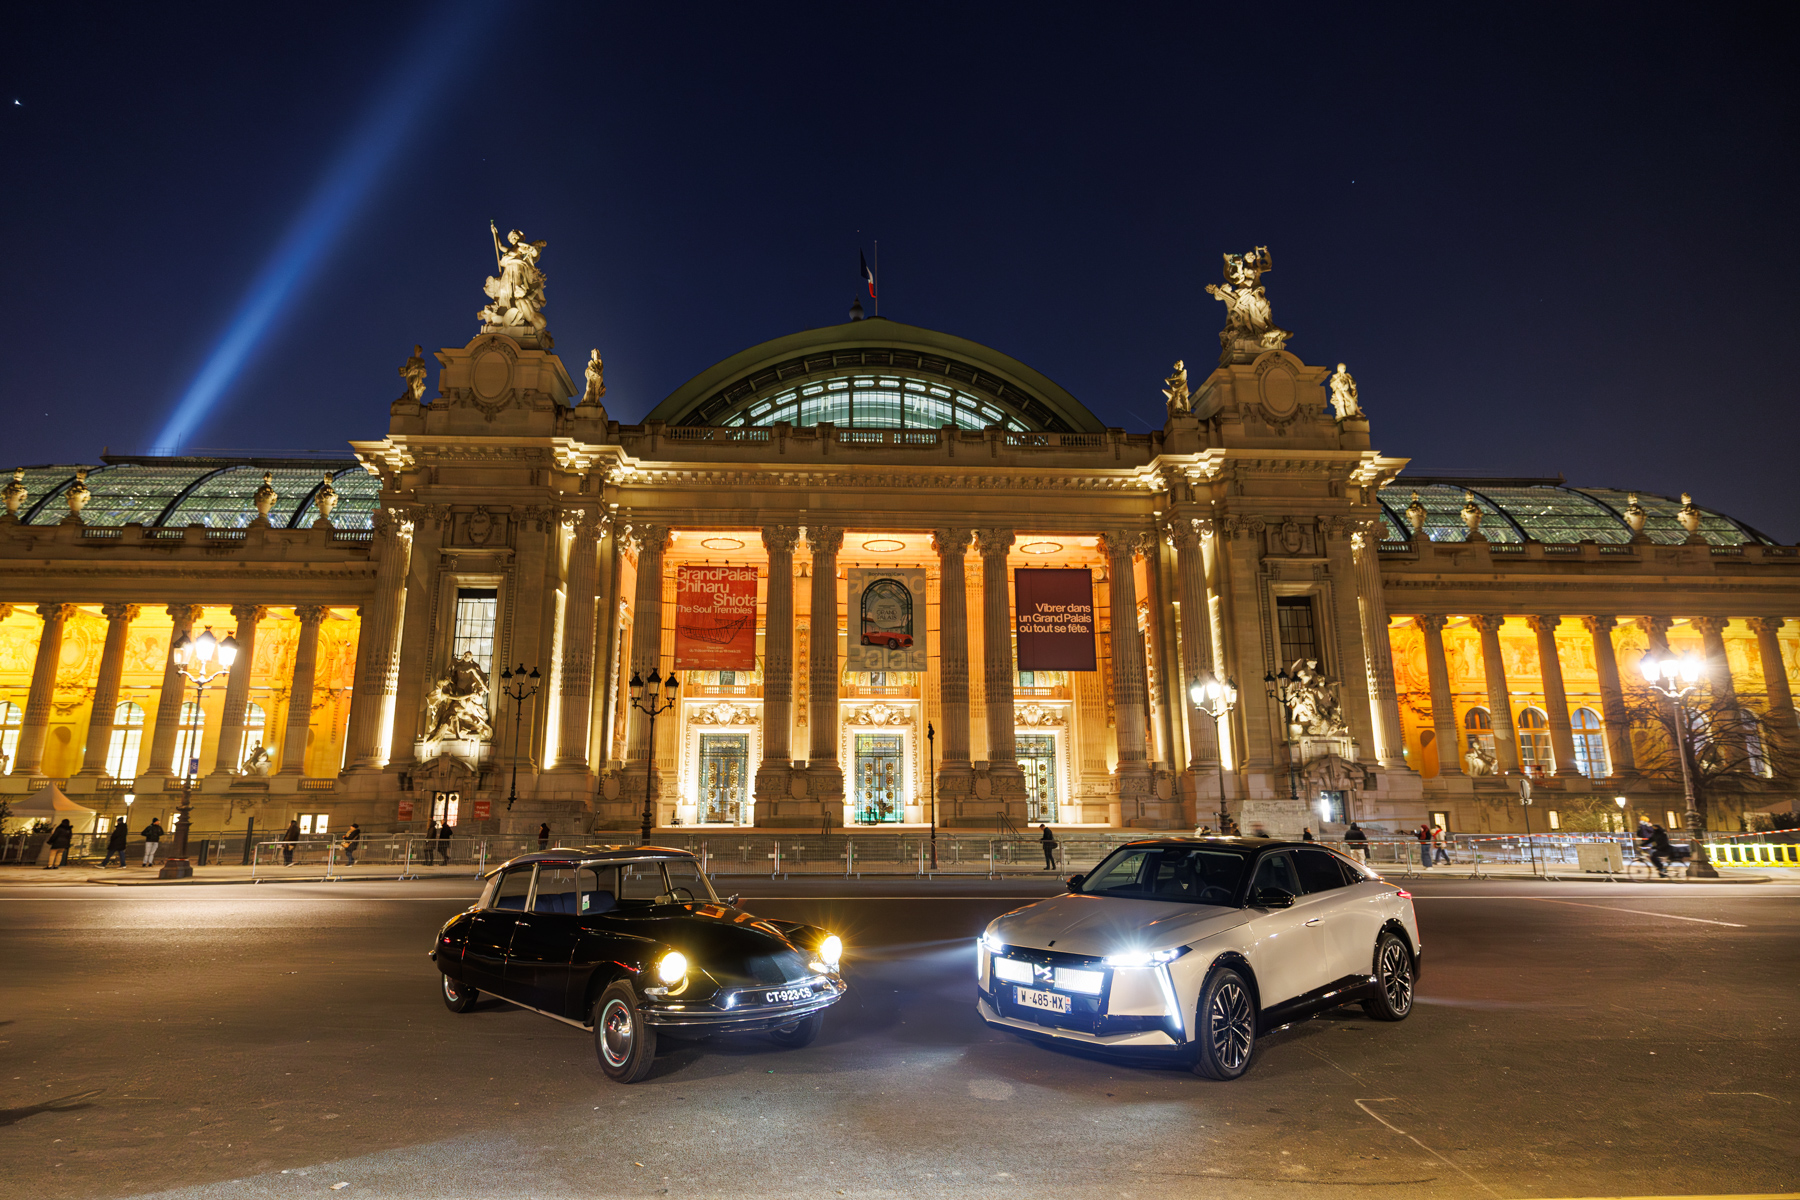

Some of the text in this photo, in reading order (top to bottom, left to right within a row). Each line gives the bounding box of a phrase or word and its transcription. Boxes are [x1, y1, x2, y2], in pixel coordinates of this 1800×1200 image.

[678, 567, 758, 581] GrandPalais
[677, 580, 729, 593] Chiharu
[713, 593, 757, 606] Shiota
[677, 605, 752, 614] The Soul Trembles
[1036, 603, 1091, 612] Vibrer dans
[1032, 614, 1062, 622] Grand
[1064, 614, 1092, 622] Palais
[1020, 624, 1032, 633] où
[1033, 624, 1053, 633] tout
[1068, 624, 1090, 633] fête.
